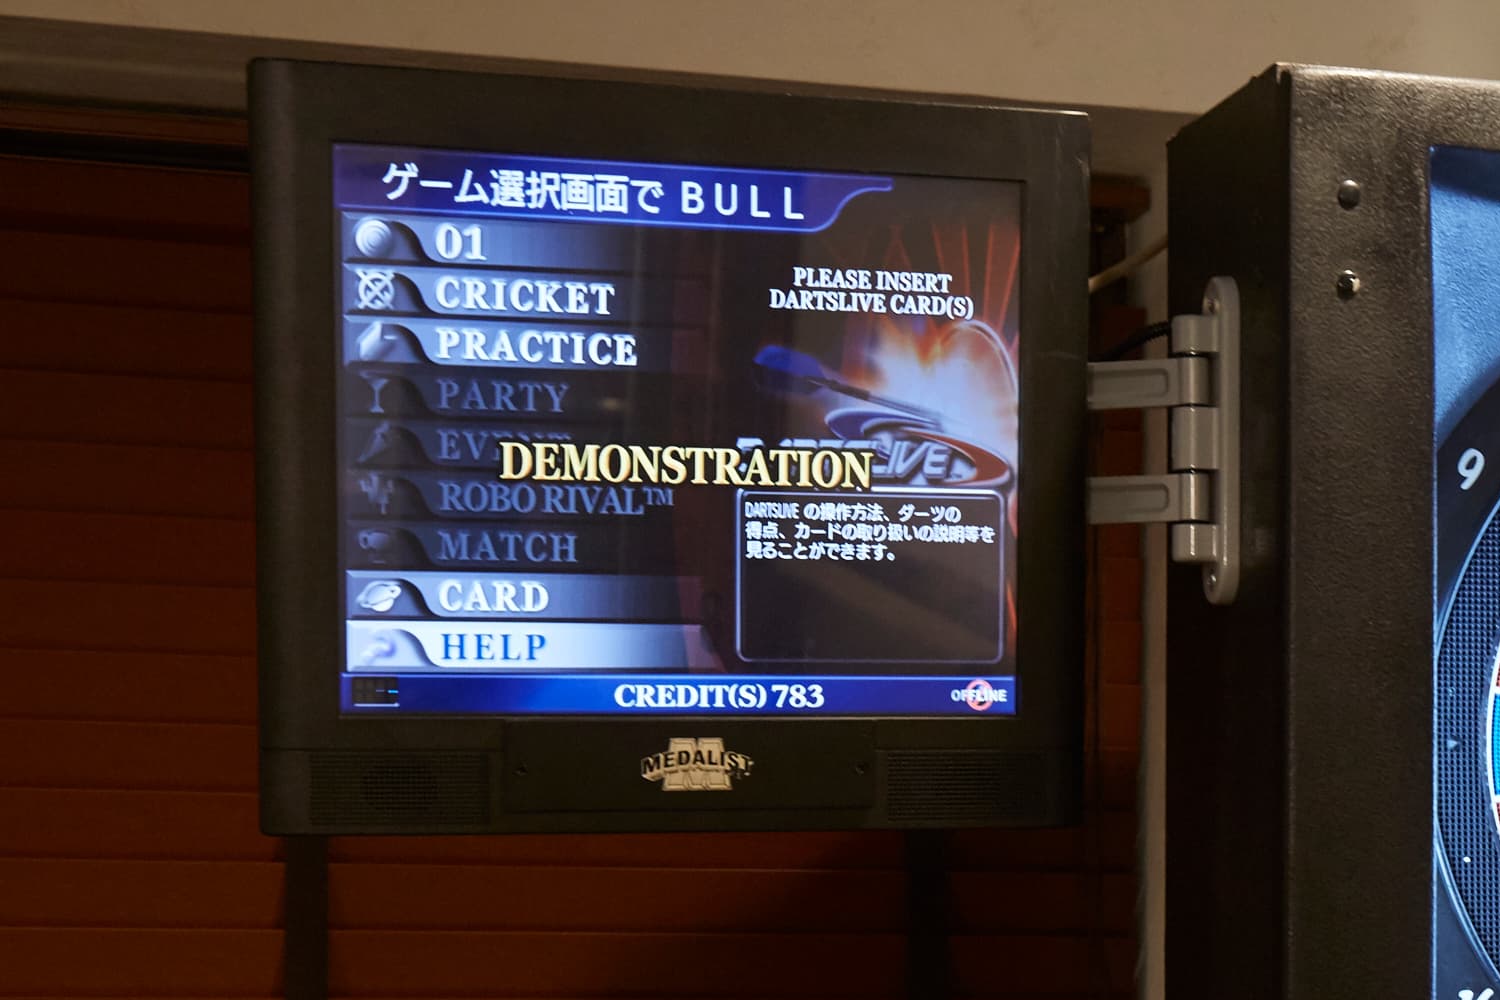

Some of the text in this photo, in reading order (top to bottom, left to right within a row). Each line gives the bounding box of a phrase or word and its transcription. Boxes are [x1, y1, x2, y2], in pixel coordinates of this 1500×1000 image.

[382, 162, 804, 220] ゲーム選択画面で BULL
[435, 223, 487, 261] 01
[435, 276, 615, 314] CRICKET
[792, 267, 952, 293] PLEASE INSERT
[769, 288, 974, 320] DARTSLIVE CARD(S)
[435, 327, 638, 366] PRACTICE
[436, 378, 570, 413] PARTY
[499, 442, 872, 489] DEMONSTRATION
[1457, 447, 1485, 490] 9
[439, 481, 536, 513] ROBO
[438, 529, 578, 563] MATCH
[745, 541, 895, 561] 見ることができます。
[439, 579, 549, 612] CARD
[441, 633, 546, 660] HELP
[614, 684, 825, 708] CREDIT(S) 783
[951, 689, 1007, 702] OFFLINE
[641, 749, 752, 775] MEDALIST
